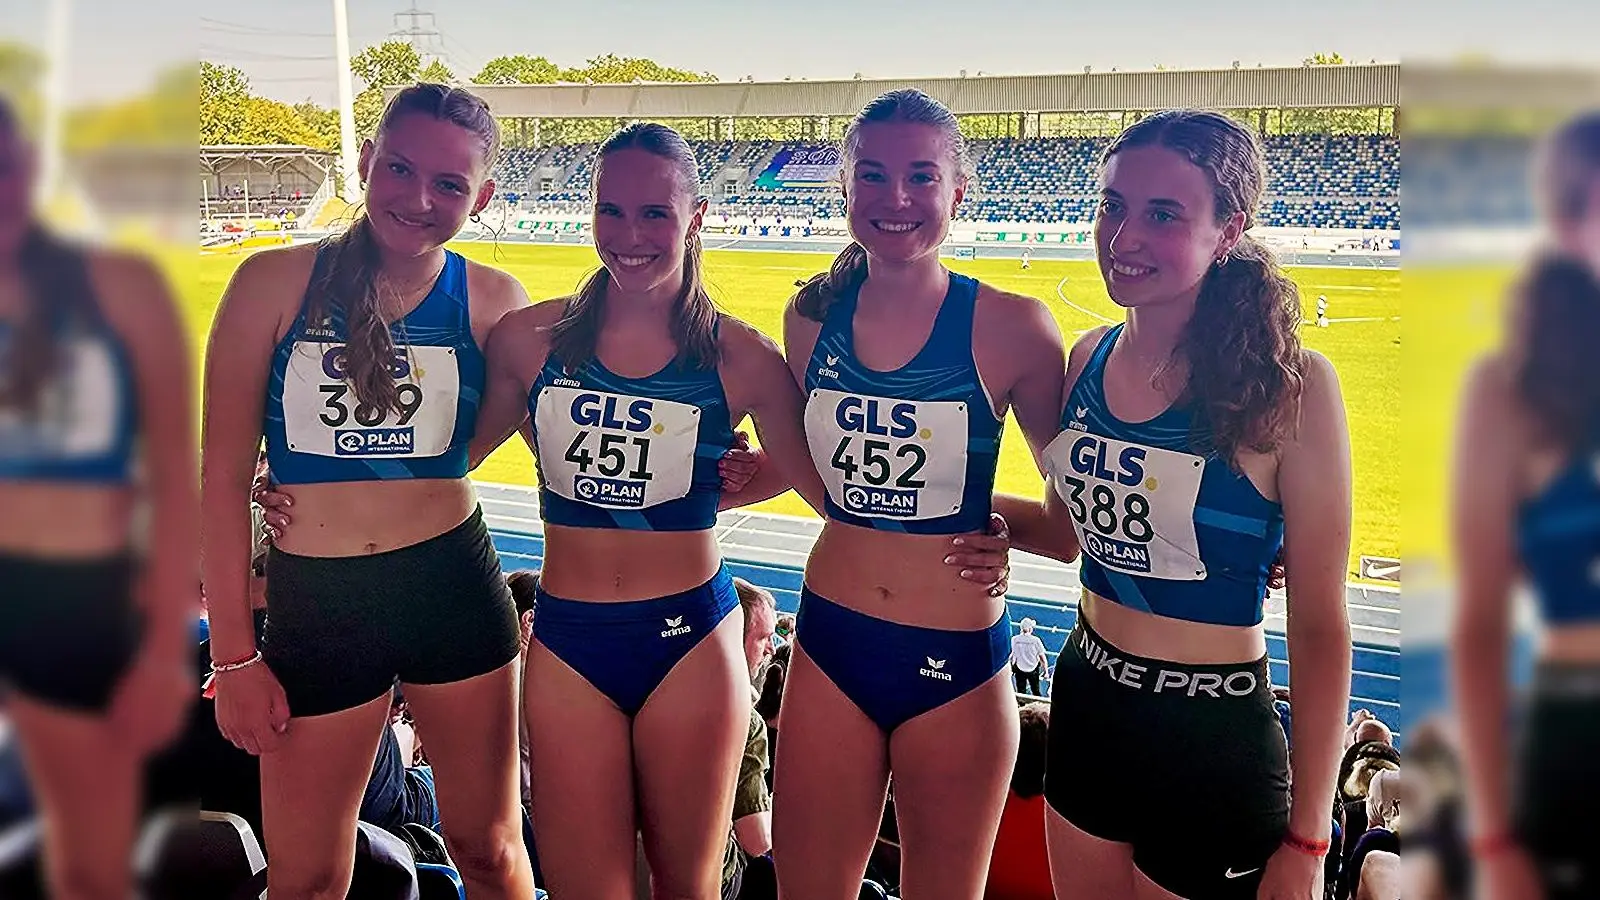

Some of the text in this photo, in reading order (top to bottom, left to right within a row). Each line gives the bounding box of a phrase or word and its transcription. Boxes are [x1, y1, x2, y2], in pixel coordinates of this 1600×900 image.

[322, 345, 411, 380] GS
[818, 367, 839, 379] erima
[553, 377, 580, 387] erima
[367, 432, 412, 446] PLAN
[564, 430, 653, 481] 451
[831, 436, 927, 489] 452
[600, 483, 643, 499] PLAN
[871, 492, 914, 508] PLAN
[1064, 475, 1155, 543] 388
[1104, 542, 1147, 562] PLAN
[660, 625, 692, 638] erima
[1078, 629, 1257, 698] NIKE PRO
[919, 667, 953, 682] erima
